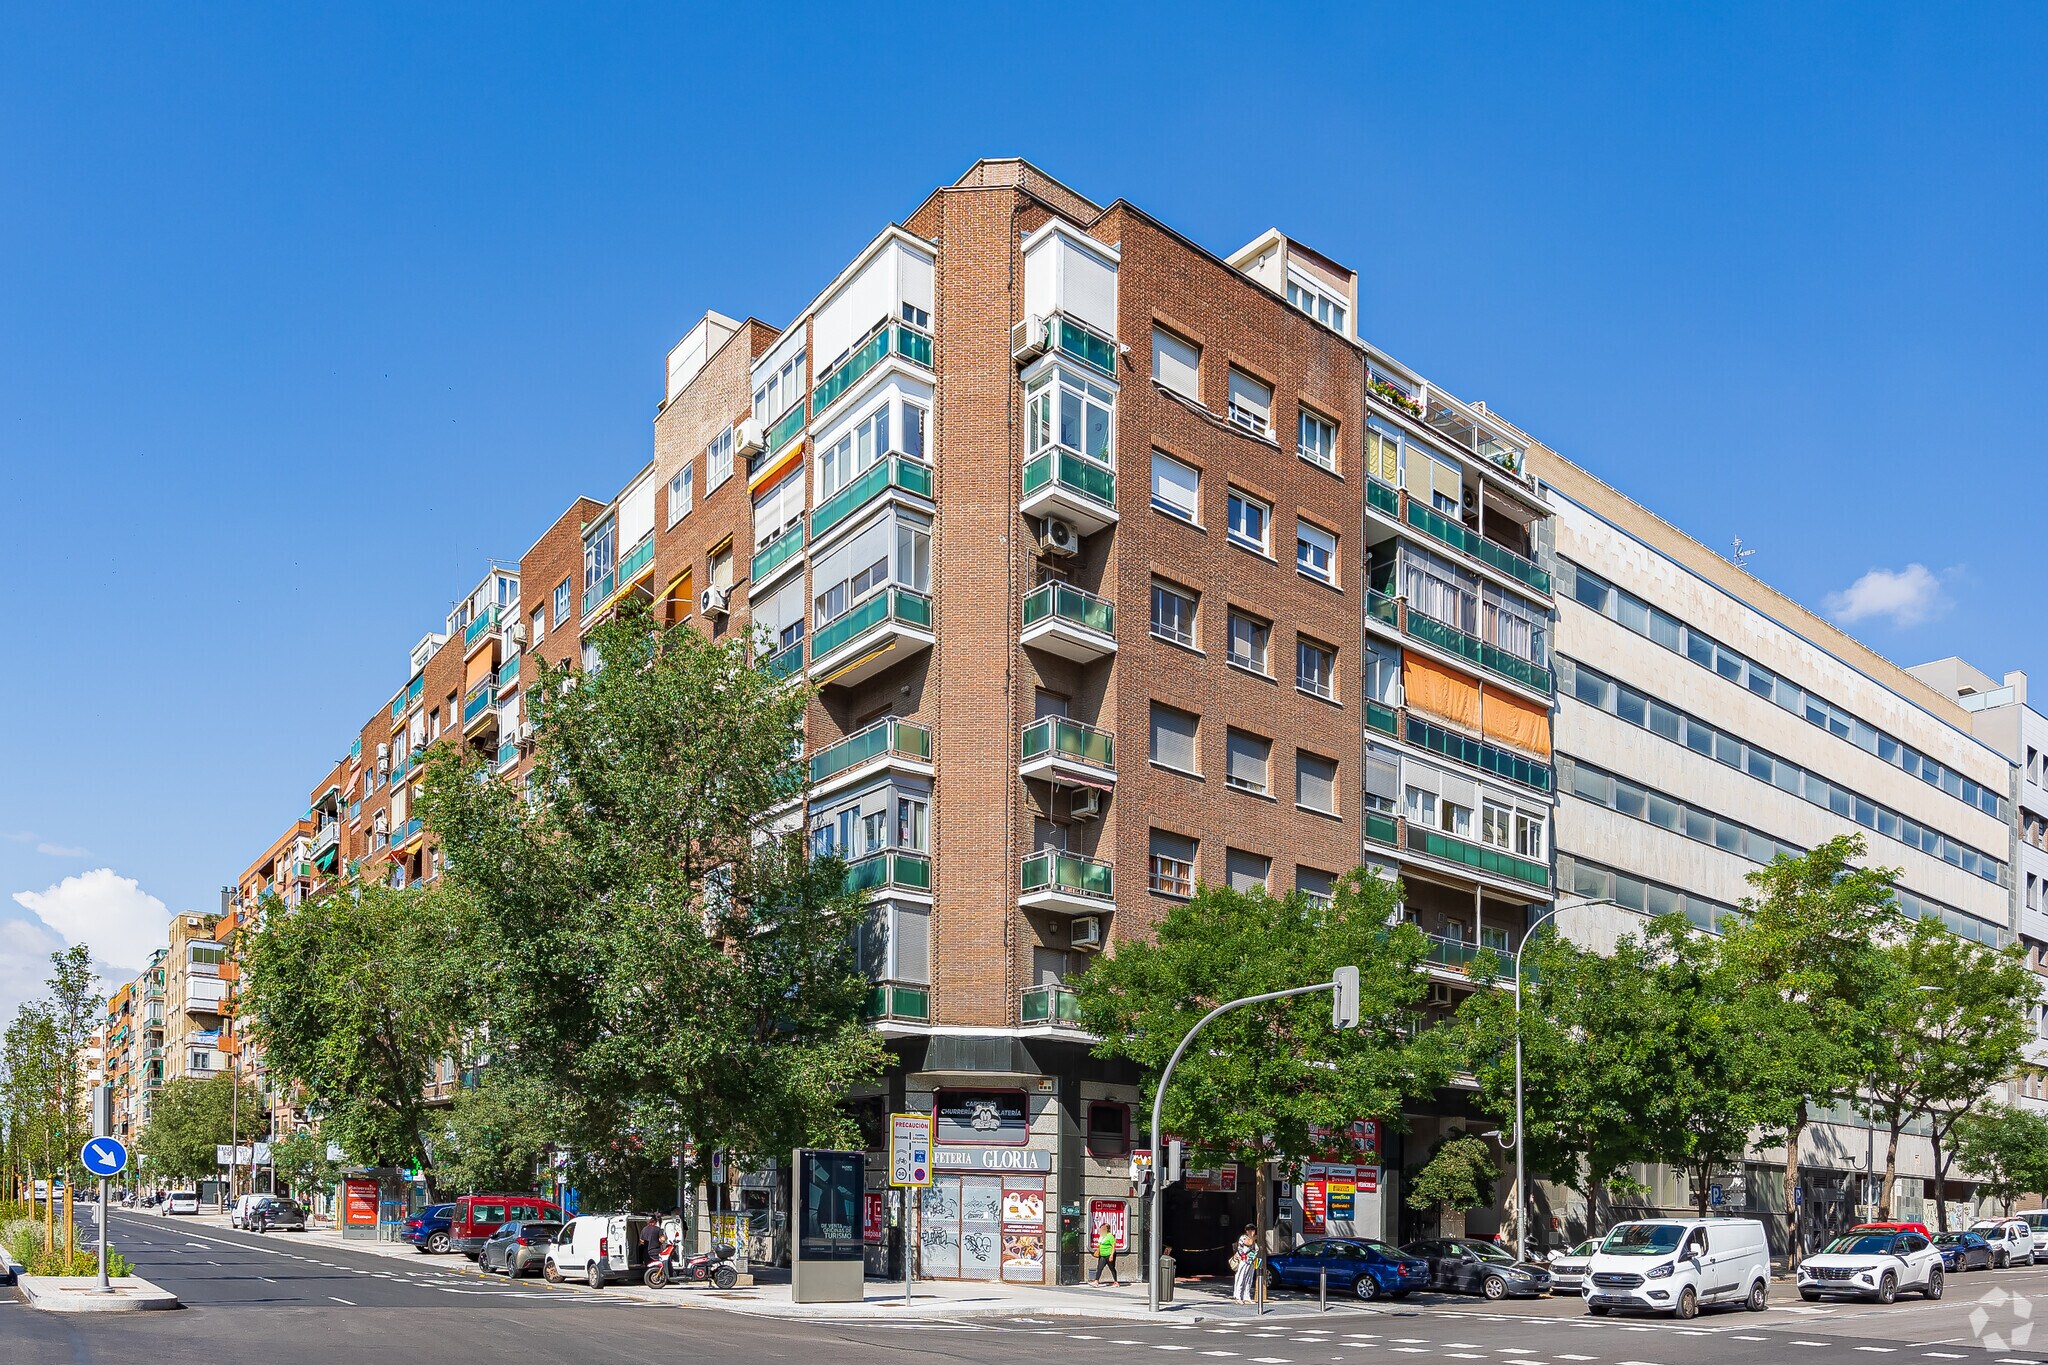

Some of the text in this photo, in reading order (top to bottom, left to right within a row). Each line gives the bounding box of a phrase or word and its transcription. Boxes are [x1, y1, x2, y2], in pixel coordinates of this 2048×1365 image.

[982, 1151, 1039, 1169] GLORIA
[1713, 1187, 1721, 1203] P
[1796, 1188, 1801, 1202] P
